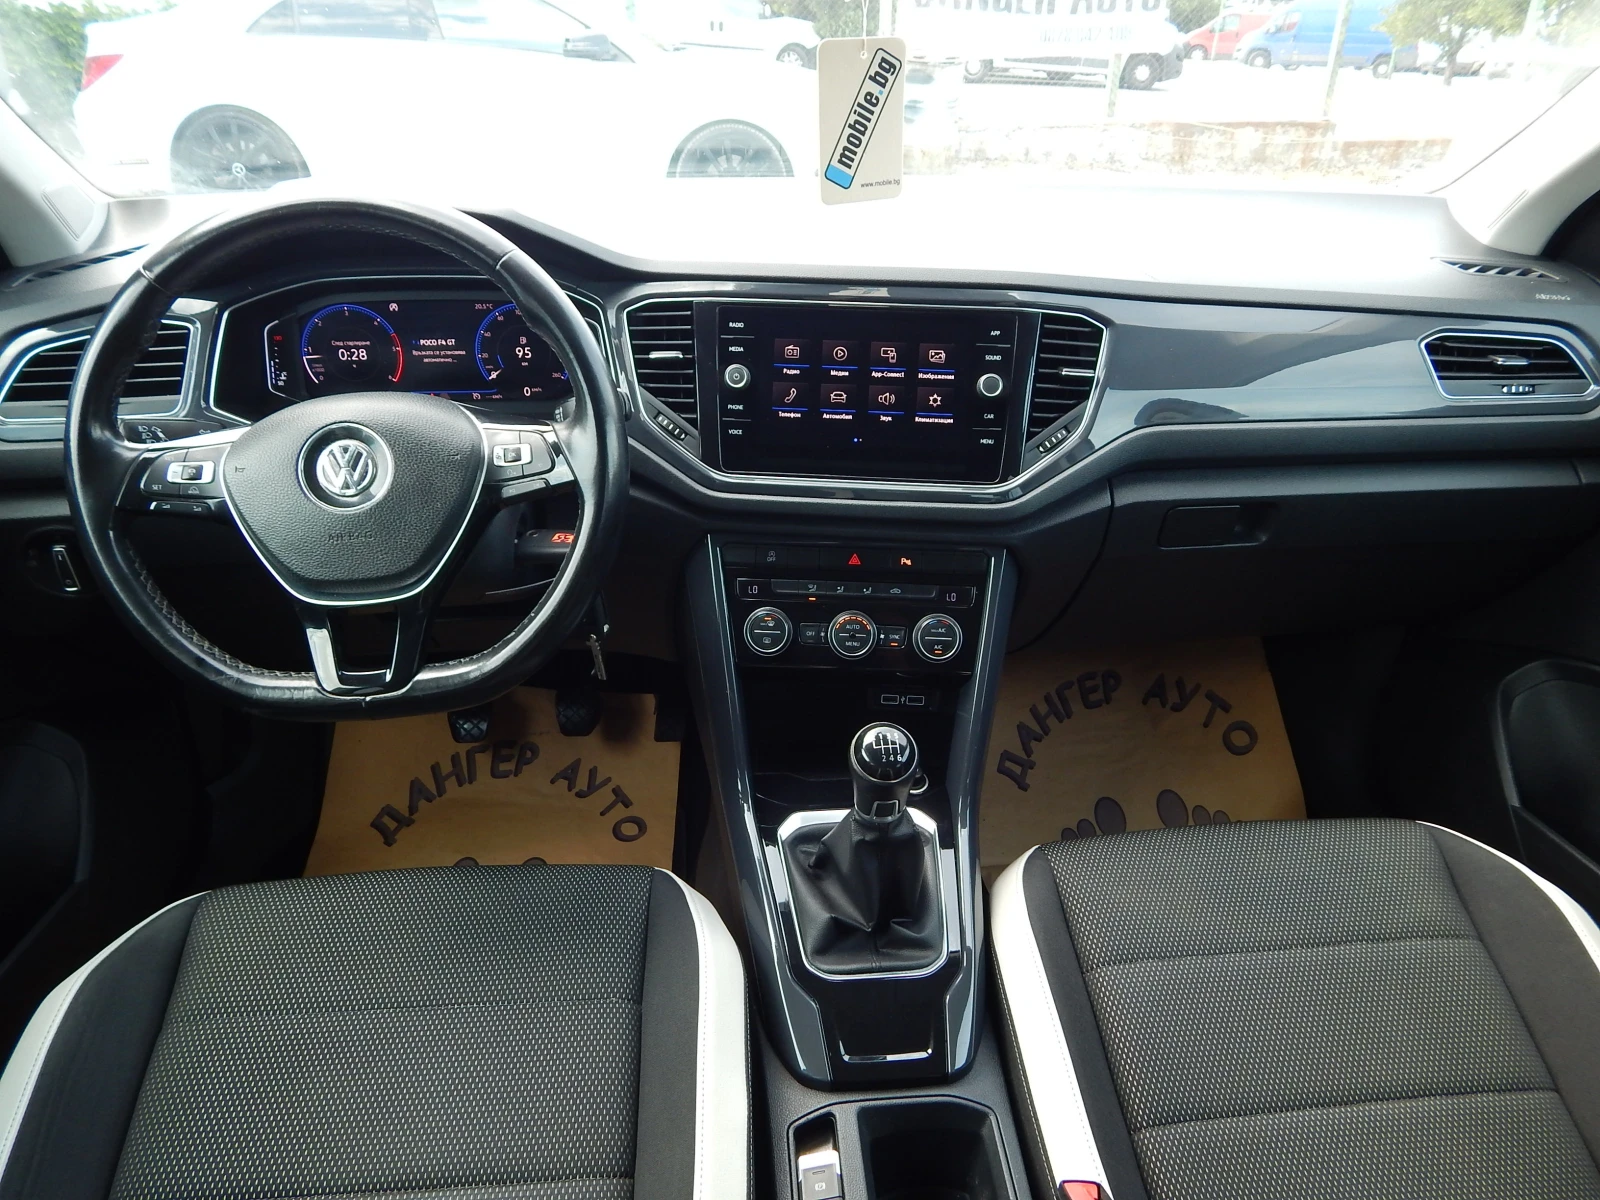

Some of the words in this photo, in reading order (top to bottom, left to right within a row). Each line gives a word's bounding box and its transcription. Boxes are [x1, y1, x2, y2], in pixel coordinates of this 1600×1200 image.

[837, 56, 897, 170] mobile.bg
[860, 178, 900, 188] www.mobile.bg
[338, 348, 368, 361] 0:28
[515, 347, 532, 359] 95
[524, 386, 531, 397] 0
[748, 585, 758, 594] LO
[946, 592, 957, 602] LO
[997, 669, 1122, 792] ДАНГЕР
[1142, 672, 1258, 756] АУТО
[370, 740, 540, 847] ДАНГЕР
[550, 758, 647, 842] АУТО
